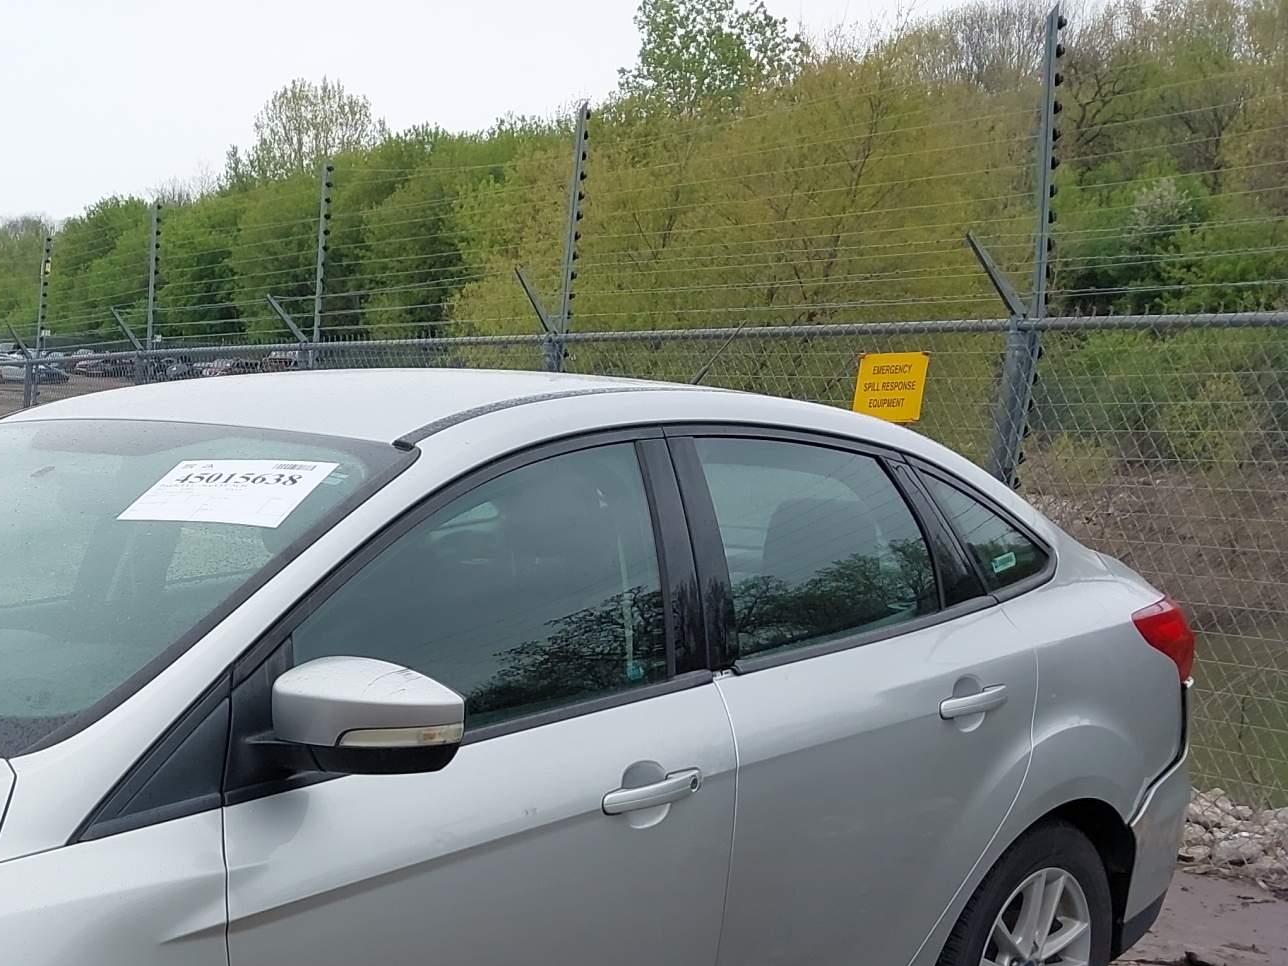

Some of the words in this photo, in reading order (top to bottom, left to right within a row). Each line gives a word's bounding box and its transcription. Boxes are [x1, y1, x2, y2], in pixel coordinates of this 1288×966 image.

[872, 364, 912, 375] EMERGENCY
[863, 382, 880, 392] SPILL
[882, 381, 916, 391] RESPONSE
[868, 398, 905, 408] EQUIPMENT
[175, 472, 303, 486] 45015638
